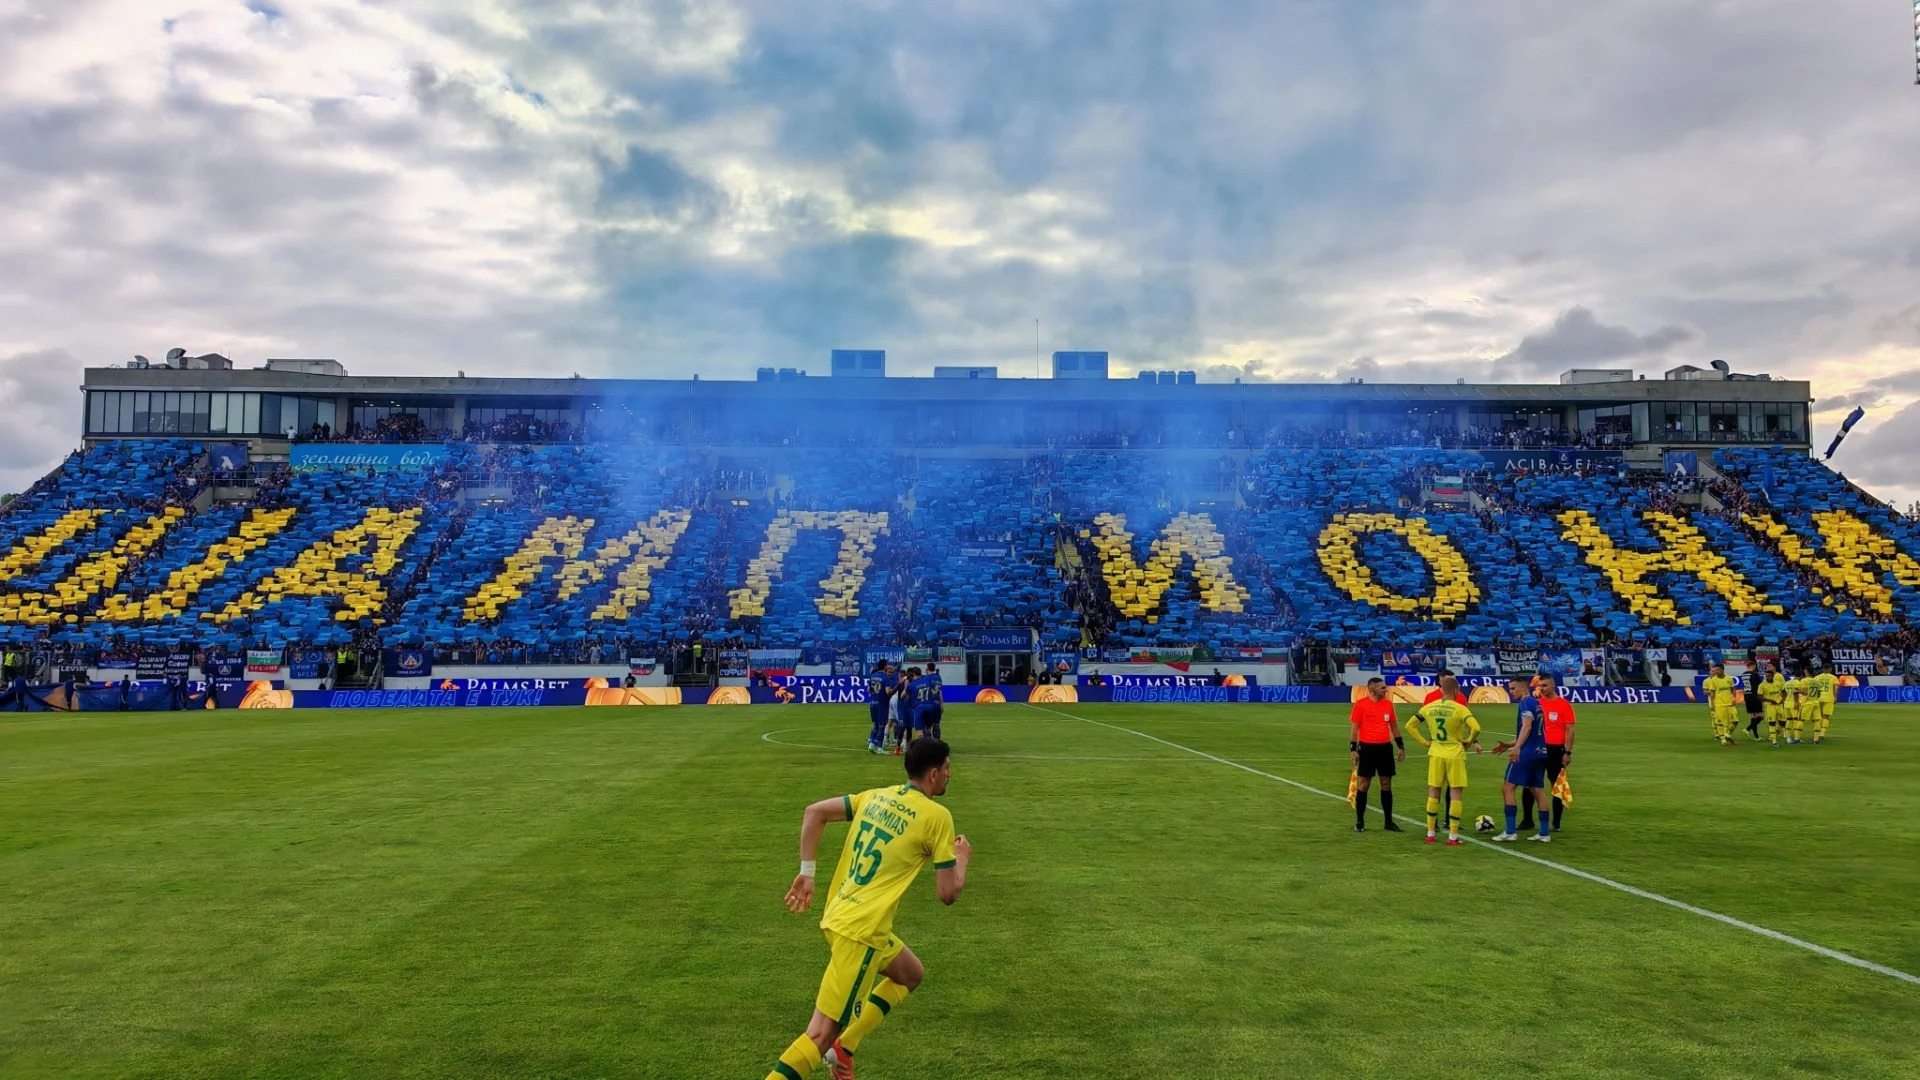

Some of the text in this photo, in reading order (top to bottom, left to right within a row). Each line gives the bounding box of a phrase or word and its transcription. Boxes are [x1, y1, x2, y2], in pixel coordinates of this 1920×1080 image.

[981, 635, 1028, 645] PALMS BET
[867, 652, 904, 664] ВЕТЕРАНИ
[1832, 650, 1873, 660] ULTRAS
[1834, 664, 1874, 675] LEVSKI
[467, 678, 529, 690] PALMS
[1111, 674, 1171, 686] PALMS
[330, 690, 456, 708] ПОБЕДАТА
[491, 689, 544, 706] ТУК!
[801, 685, 865, 703] PALMS
[1112, 685, 1229, 703] ПОБЕДАТА
[1260, 685, 1309, 702] ТУК!
[1558, 686, 1660, 703] PALMS BET
[1848, 686, 1878, 703] ДО
[1435, 718, 1447, 741] 3
[863, 802, 908, 836] NACHMIAS
[848, 819, 895, 886] 55
